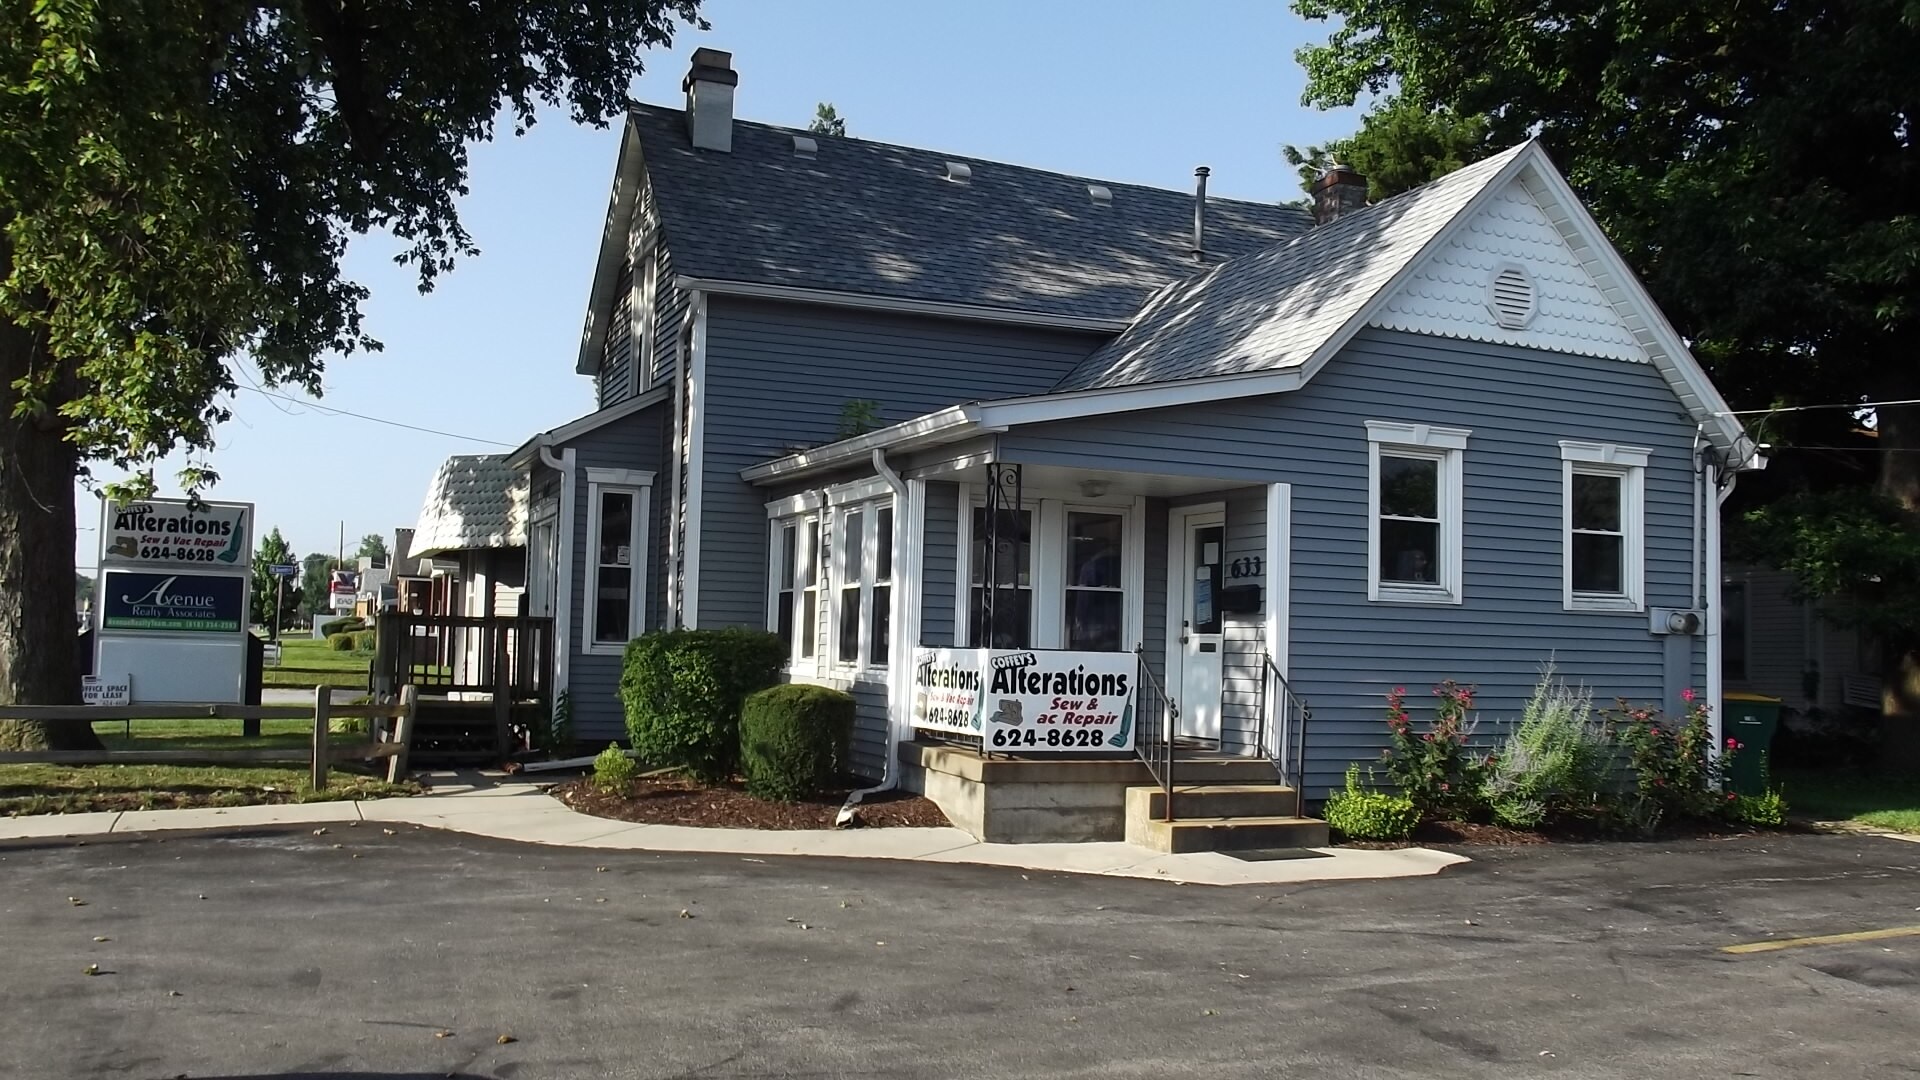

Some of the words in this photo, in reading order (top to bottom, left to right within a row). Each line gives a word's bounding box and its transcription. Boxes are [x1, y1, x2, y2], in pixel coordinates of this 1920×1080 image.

[114, 512, 231, 536] Alterations
[140, 535, 160, 544] Sew
[162, 536, 169, 545] &
[173, 537, 194, 545] Vac
[194, 538, 228, 548] Repair
[141, 546, 215, 561] 624-8628
[1231, 556, 1261, 578] 633
[122, 575, 215, 607] Avenue
[132, 606, 161, 617] Realty
[166, 607, 217, 619] Associates
[991, 652, 1036, 669] COFFEY'S
[915, 661, 979, 691] Alterations
[990, 664, 1128, 696] Alterations
[946, 693, 955, 703] Vac
[957, 694, 975, 707] Repair
[1050, 697, 1083, 711] Sew
[1086, 697, 1099, 711] &
[928, 707, 969, 727] 624-8628
[1062, 711, 1118, 727] Repair
[992, 729, 1104, 747] 624-8628
